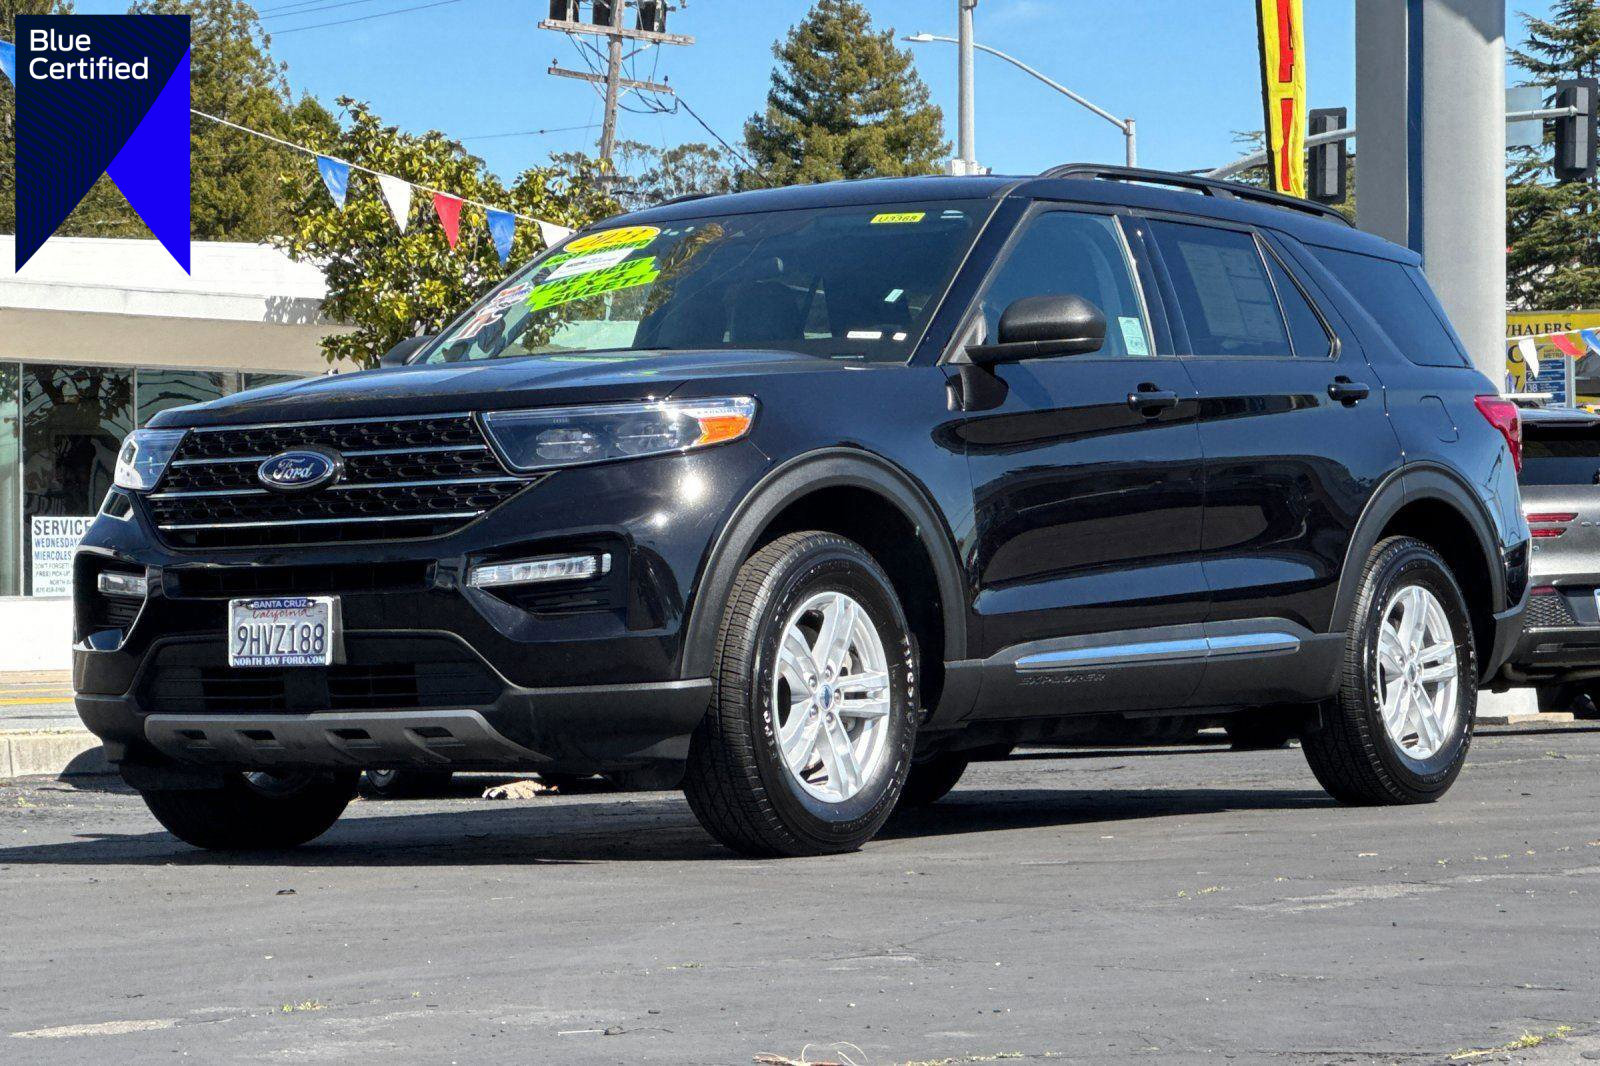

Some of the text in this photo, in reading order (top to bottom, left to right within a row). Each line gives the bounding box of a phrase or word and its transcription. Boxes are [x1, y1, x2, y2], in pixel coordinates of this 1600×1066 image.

[587, 259, 643, 279] NEW
[273, 458, 315, 480] Ford
[34, 550, 72, 561] MIERCOLES
[253, 599, 308, 609] SANTA CRUZ
[252, 608, 314, 622] California
[237, 622, 325, 656] 9HVZ188
[233, 655, 325, 666] NORTH BAY FORD.COM
